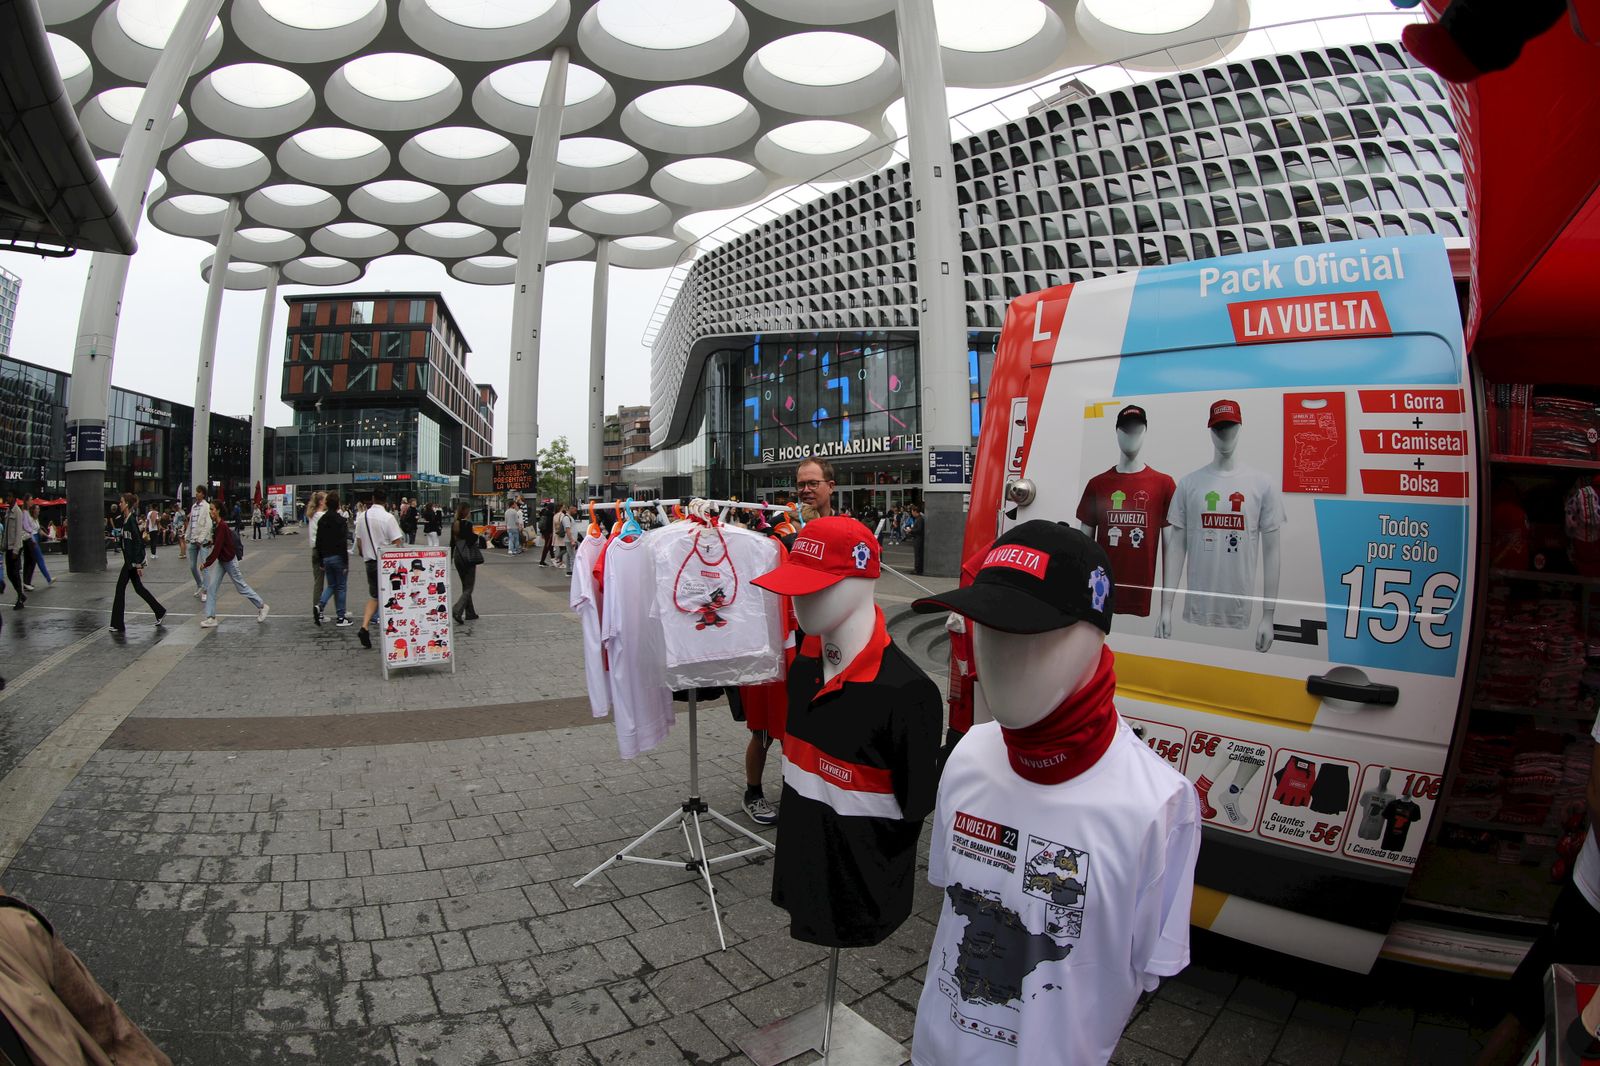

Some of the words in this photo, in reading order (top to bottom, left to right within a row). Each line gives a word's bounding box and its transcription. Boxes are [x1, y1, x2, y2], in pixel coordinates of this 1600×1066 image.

[1200, 260, 1283, 297] Pack
[1294, 248, 1404, 286] Oficial
[1243, 307, 1274, 337] LA
[1277, 300, 1376, 333] VUELTA
[1390, 393, 1396, 409] 1
[1404, 393, 1444, 409] Gorra
[779, 444, 810, 460] HOOG
[813, 436, 890, 456] CATHARIJNE
[896, 433, 922, 450] THE
[1378, 432, 1383, 449] 1
[1391, 432, 1460, 450] Camiseta
[10, 471, 23, 479] KFC
[1400, 474, 1439, 492] Bolsa
[1110, 513, 1119, 523] LA
[1119, 513, 1145, 524] VUELTA
[1204, 515, 1213, 526] LA
[1214, 516, 1242, 527] VUELTA
[1379, 514, 1429, 538] Todos
[995, 548, 1040, 570] VUELTA
[1367, 542, 1396, 562] por
[1402, 541, 1438, 562] sólo
[383, 560, 397, 568] 20€
[1340, 565, 1460, 649] 15€
[410, 628, 420, 636] 5€
[388, 652, 397, 660] 5€
[1148, 738, 1183, 762] 15€
[1191, 733, 1221, 757] 5€
[1227, 741, 1234, 750] 2
[1234, 743, 1254, 754] pares
[1255, 745, 1265, 757] de
[1030, 753, 1067, 768] VUELTA
[1228, 752, 1266, 766] calcetines
[828, 766, 848, 780] VUELTA
[1402, 774, 1441, 800] 10€
[1271, 812, 1305, 828] Guantes
[956, 815, 965, 830] LA
[966, 818, 997, 840] VUELTA
[1003, 830, 1016, 846] 22
[1310, 821, 1342, 845] 5€
[970, 841, 993, 855] BRABANT
[1353, 844, 1386, 858] Camiseta
[1387, 851, 1399, 861] top
